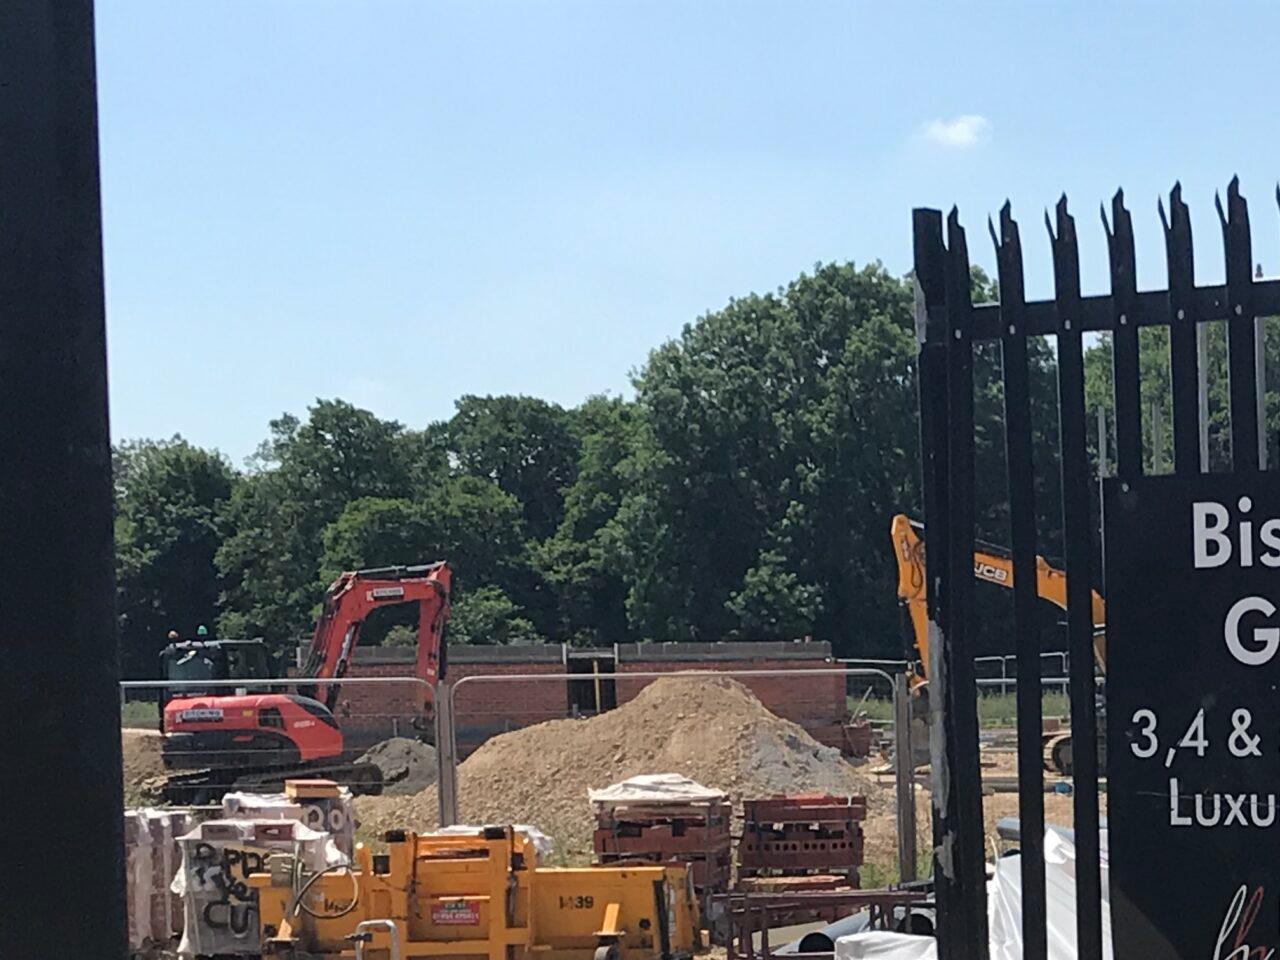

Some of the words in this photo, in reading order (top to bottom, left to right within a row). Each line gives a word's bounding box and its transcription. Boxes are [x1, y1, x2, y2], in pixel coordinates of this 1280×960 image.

[974, 563, 1007, 582] JCB
[1131, 708, 1208, 767] 3,4
[1228, 709, 1262, 757] &
